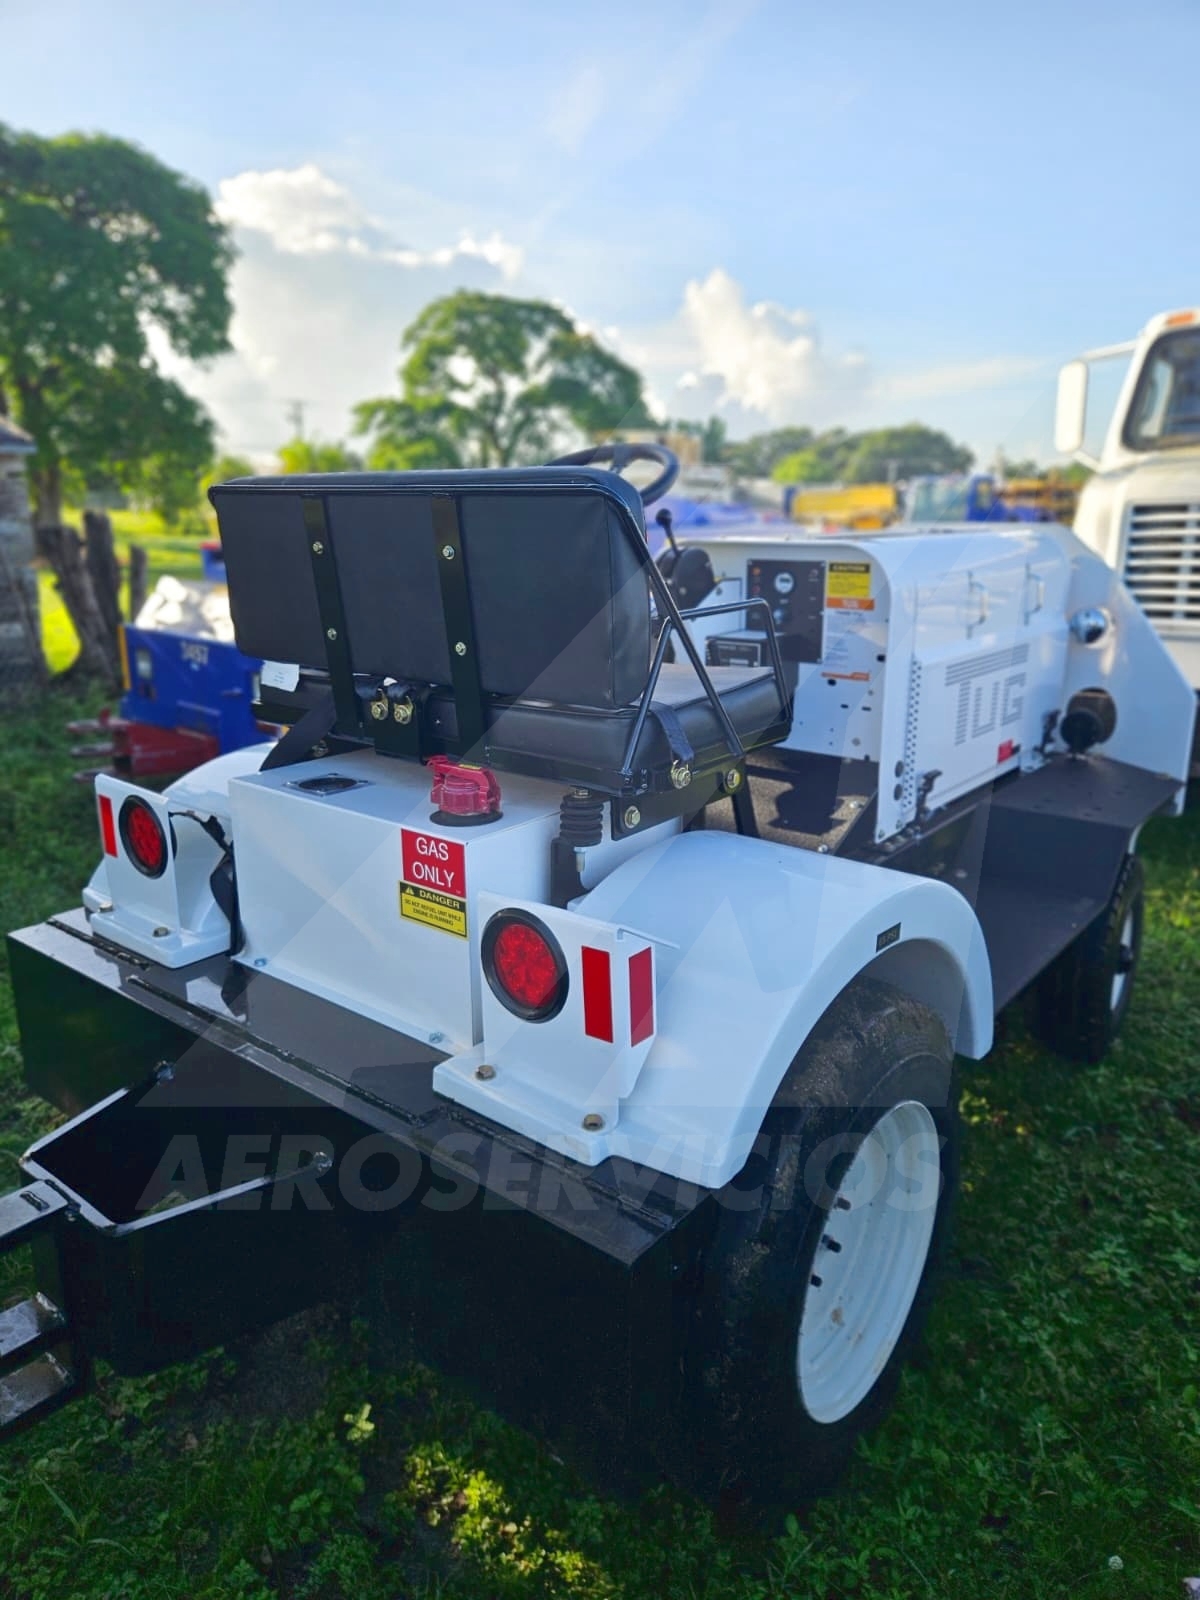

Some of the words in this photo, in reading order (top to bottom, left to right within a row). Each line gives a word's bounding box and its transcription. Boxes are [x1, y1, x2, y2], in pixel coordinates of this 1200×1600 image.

[945, 643, 1029, 746] TUG
[416, 837, 449, 861] GAS
[412, 861, 455, 888] ONLY
[419, 889, 460, 909] DANGER
